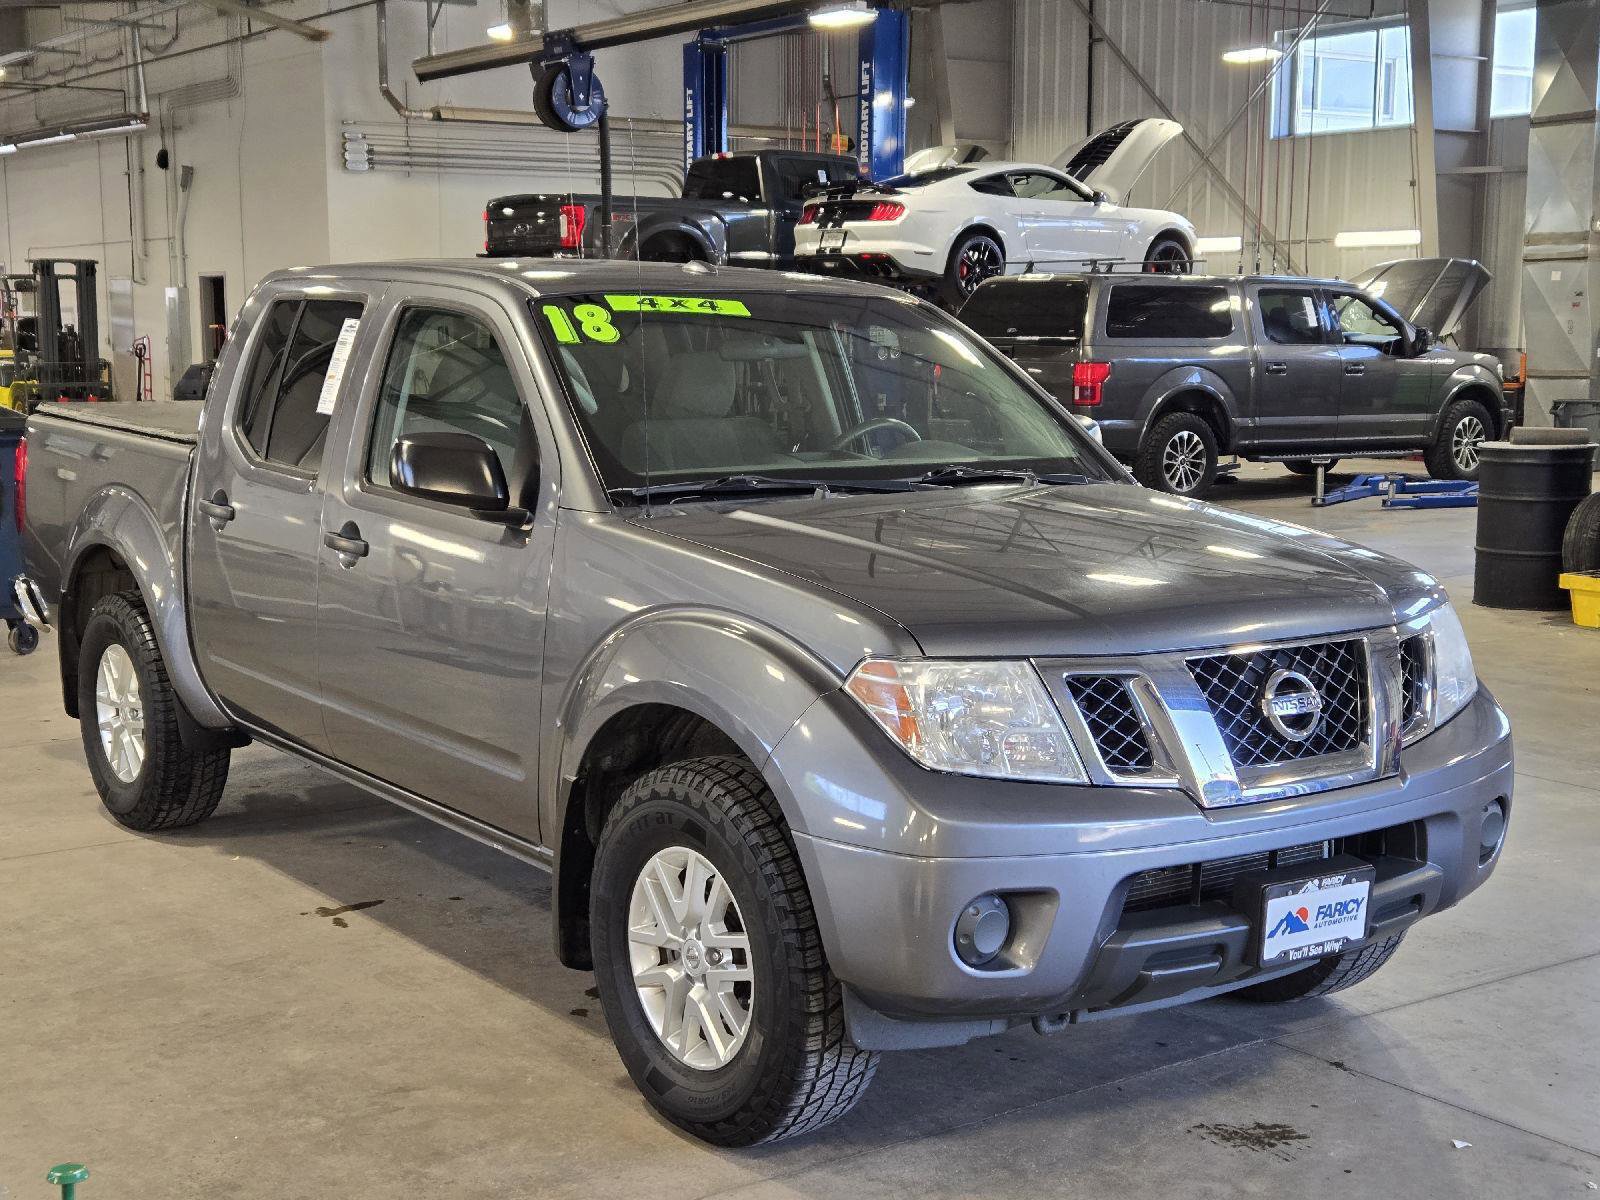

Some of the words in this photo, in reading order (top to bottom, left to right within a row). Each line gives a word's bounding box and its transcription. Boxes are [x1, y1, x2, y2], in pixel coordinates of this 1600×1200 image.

[862, 61, 870, 94] LIFT
[861, 100, 869, 162] ROTARY
[542, 304, 620, 344] 18
[1272, 696, 1318, 711] NISSAN
[1314, 914, 1358, 928] AUTOMOTIVE
[1315, 897, 1365, 921] FARICY
[1289, 947, 1309, 960] You'll
[1309, 945, 1322, 956] See
[1324, 939, 1343, 953] Why!
